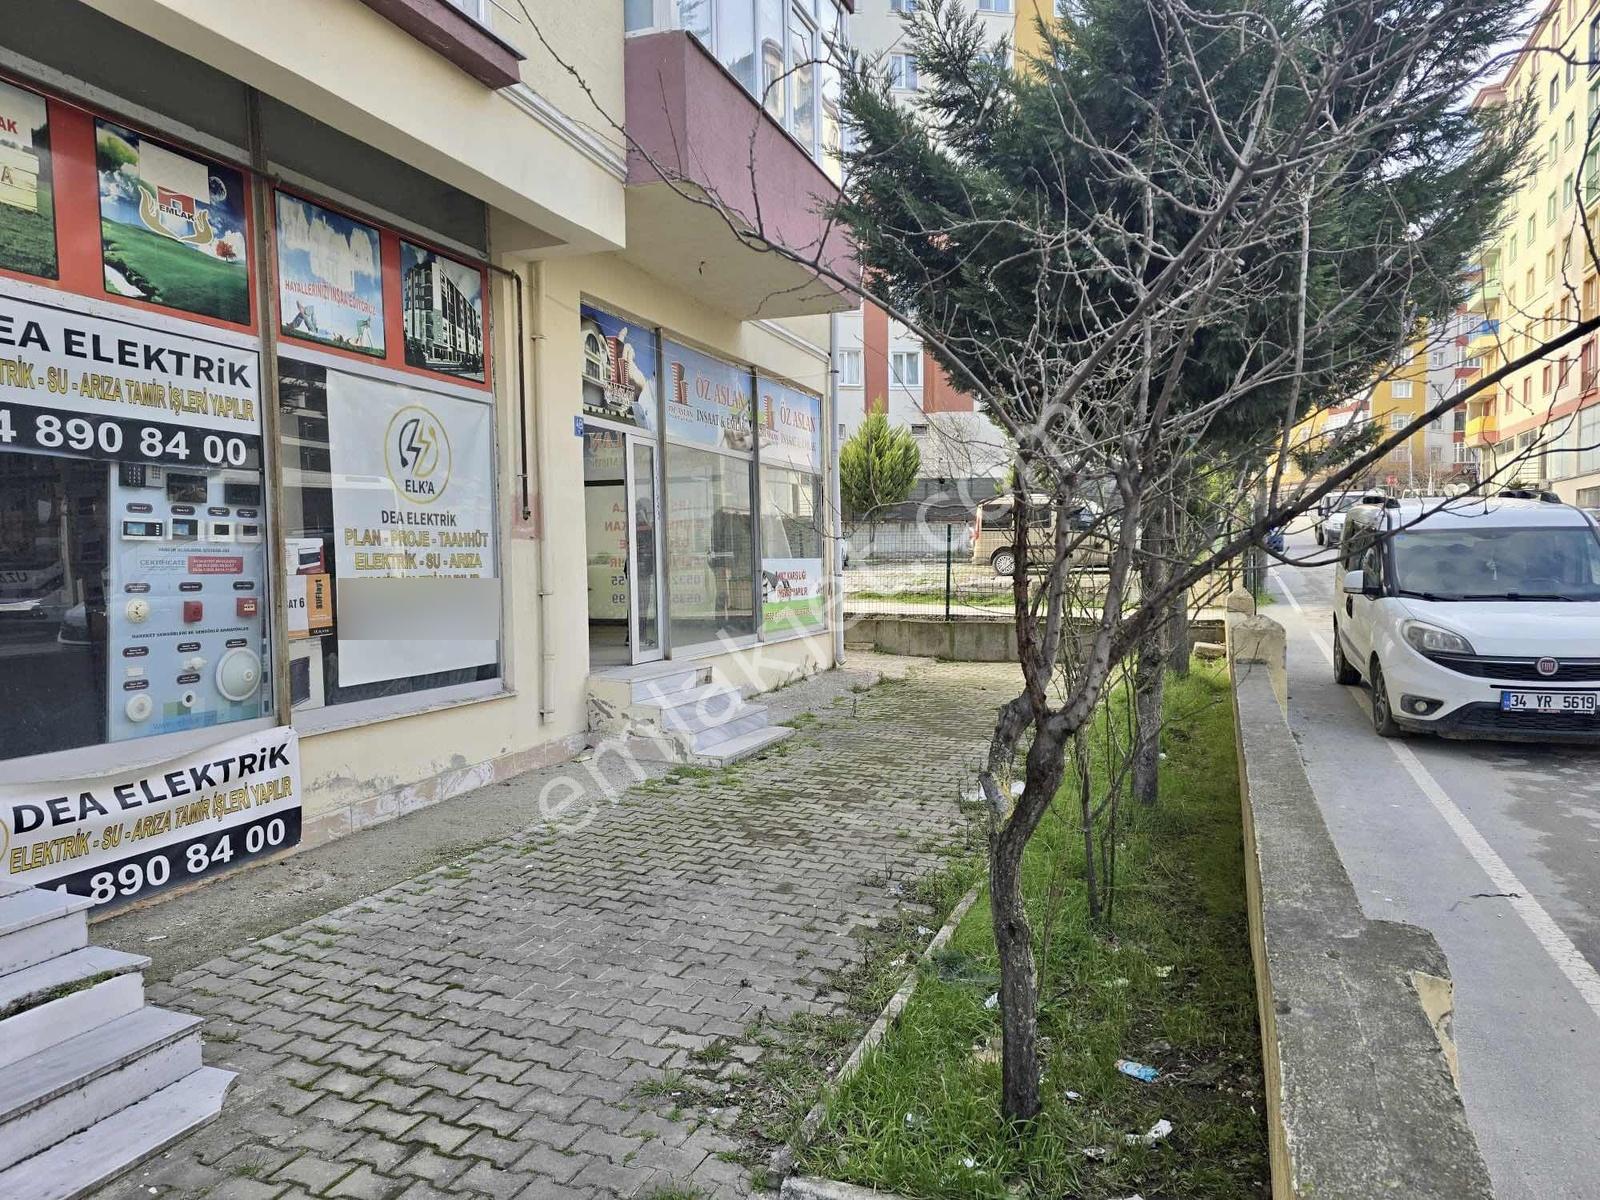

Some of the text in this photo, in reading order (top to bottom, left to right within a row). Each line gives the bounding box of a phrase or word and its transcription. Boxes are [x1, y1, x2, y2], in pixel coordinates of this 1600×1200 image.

[0, 116, 18, 135] AK
[159, 203, 196, 223] EMLAK
[0, 314, 50, 352] EA
[0, 355, 35, 390] TRİK
[47, 366, 68, 396] SU
[80, 372, 124, 403] ARIZA
[125, 378, 166, 410] TAMİR
[168, 384, 209, 416] İŞLERİ
[208, 392, 255, 422] YAPILIR
[696, 371, 746, 410] ÖZ ASLAN
[780, 401, 816, 432] ÖZ ASLAN
[0, 409, 246, 466] 4 890 84 00
[381, 510, 405, 525] DEA
[344, 528, 382, 547] PLAN
[390, 530, 430, 548] PROJE
[354, 550, 417, 570] ELEKTRİK
[426, 552, 441, 570] SU
[448, 552, 482, 569] ARIZA
[288, 597, 305, 609] AT 6
[1542, 662, 1554, 671] FIAT
[1511, 694, 1594, 709] 34 YR 5619
[10, 828, 93, 874] ELEKTRİK
[102, 823, 124, 850] SU
[130, 813, 172, 842] ARIZA
[174, 797, 211, 829] TAMİR
[212, 781, 250, 822] İŞLERİ
[250, 776, 292, 808] YAPILIR
[12, 792, 108, 835] DEA
[90, 818, 286, 904] 890 84 00
